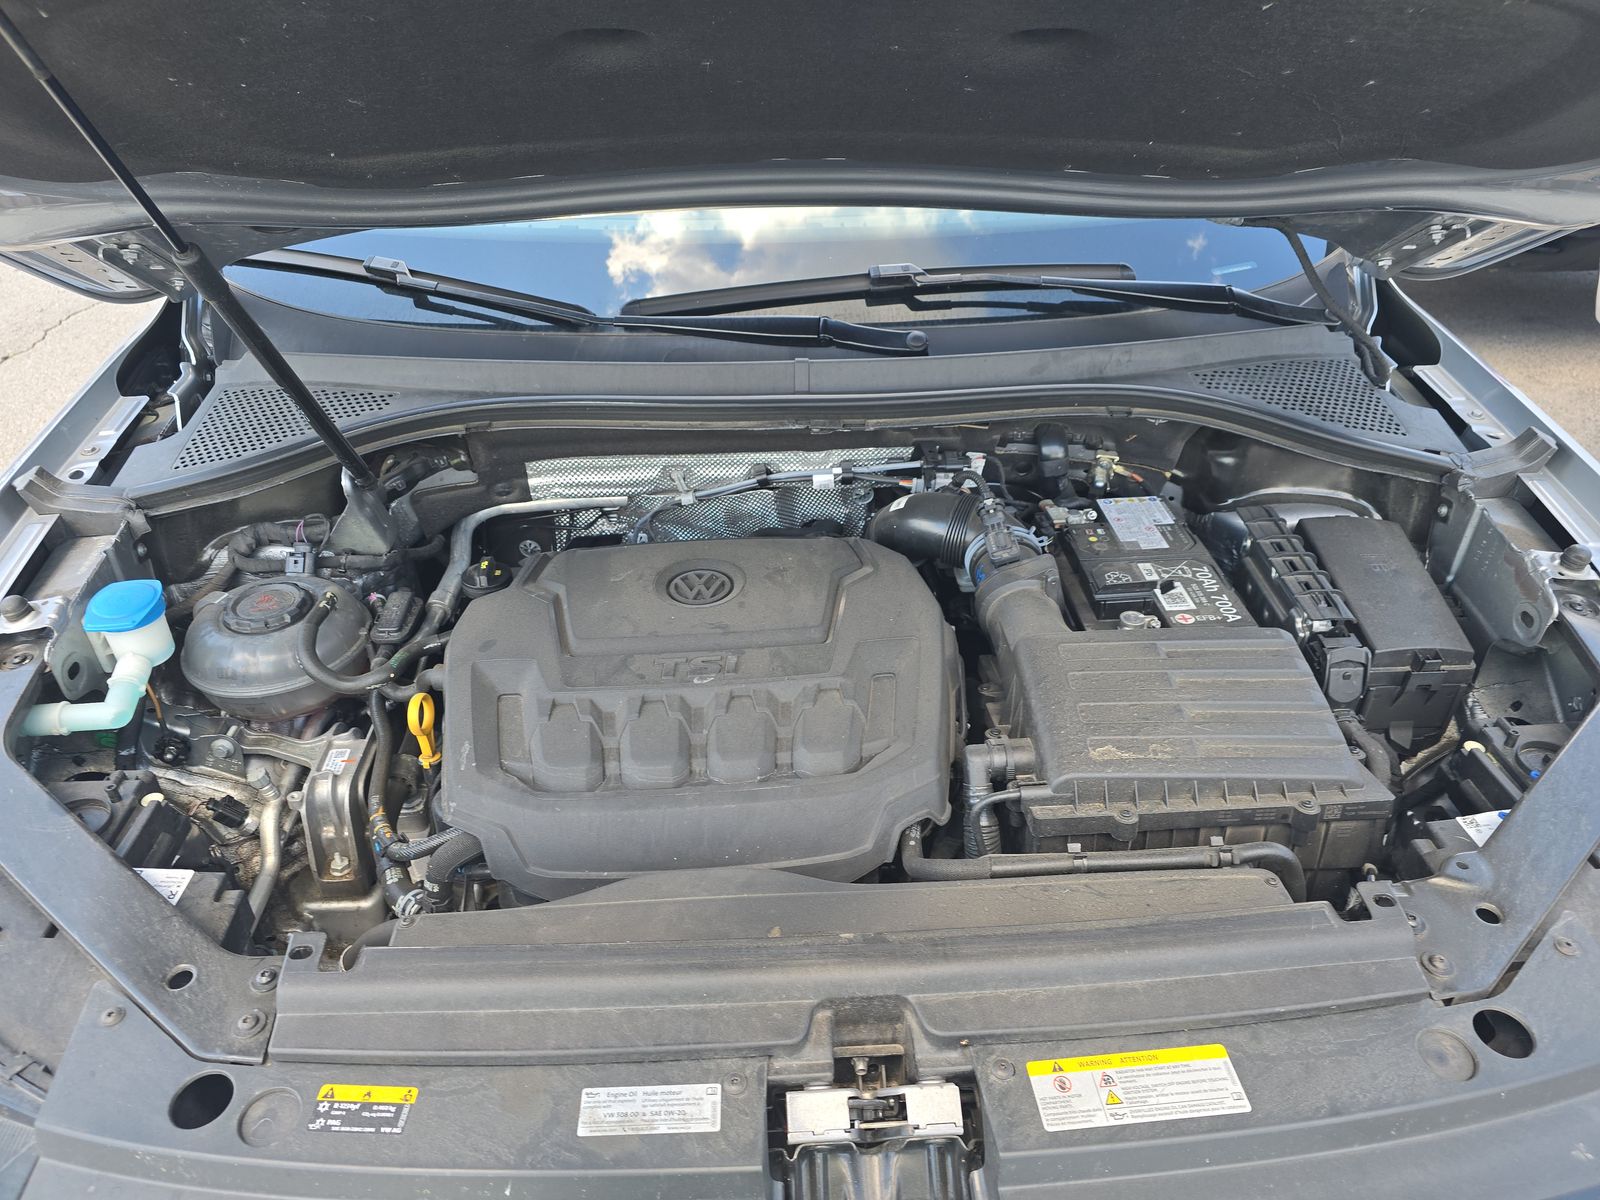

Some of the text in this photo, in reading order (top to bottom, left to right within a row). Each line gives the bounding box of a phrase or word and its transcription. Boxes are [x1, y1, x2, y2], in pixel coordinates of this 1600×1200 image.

[1192, 566, 1220, 592] 70Ah
[1211, 594, 1242, 623] 700A
[654, 655, 739, 680] TSI
[1077, 1054, 1159, 1068] WARNING ATTENTION
[606, 1091, 628, 1099] Engine
